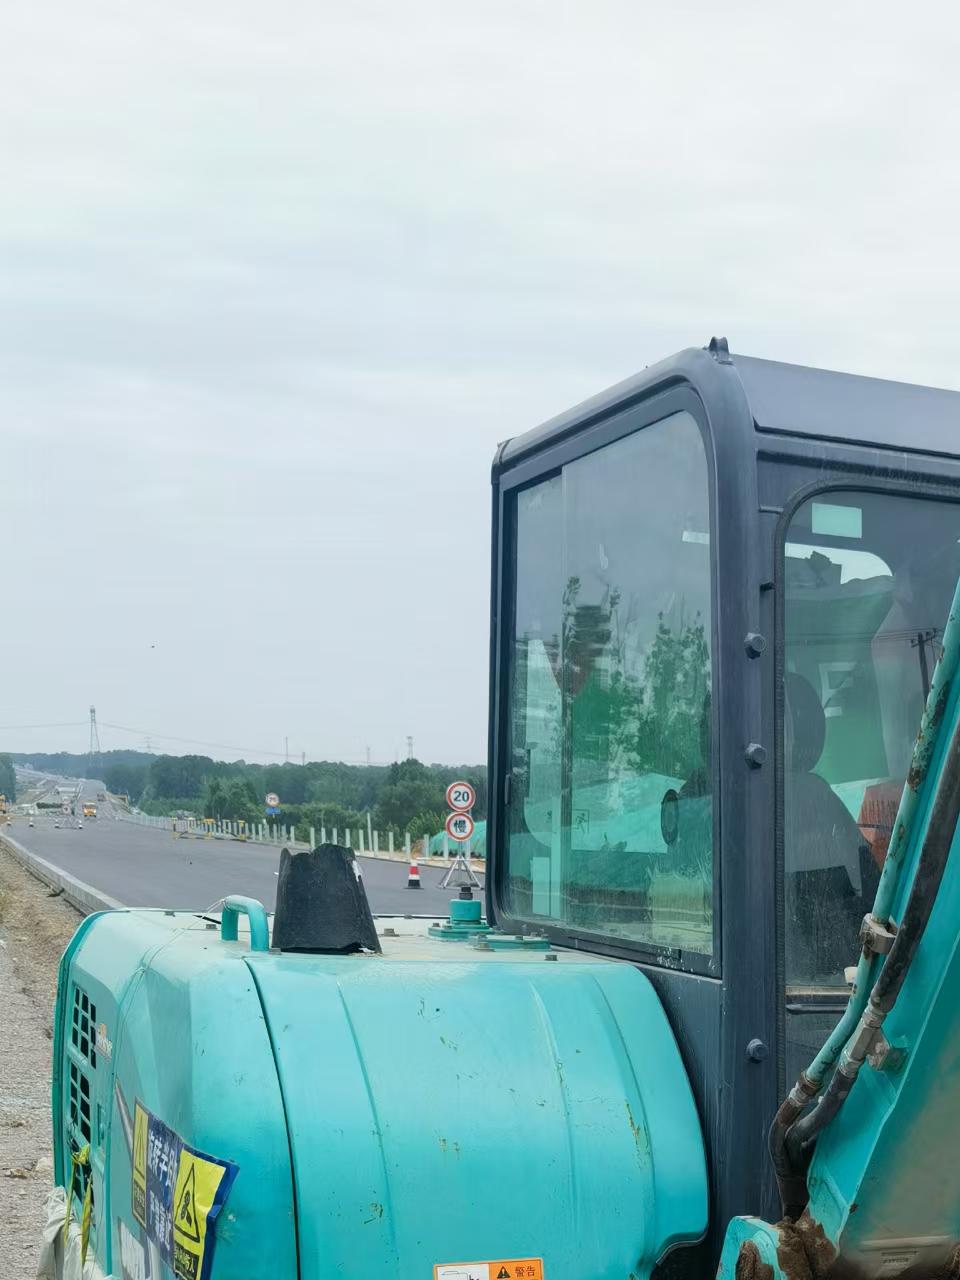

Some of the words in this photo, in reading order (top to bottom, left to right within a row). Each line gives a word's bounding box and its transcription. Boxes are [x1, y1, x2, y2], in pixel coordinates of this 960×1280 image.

[454, 790, 469, 802] 20
[453, 819, 467, 833] 慢
[515, 1265, 536, 1278] 警告
